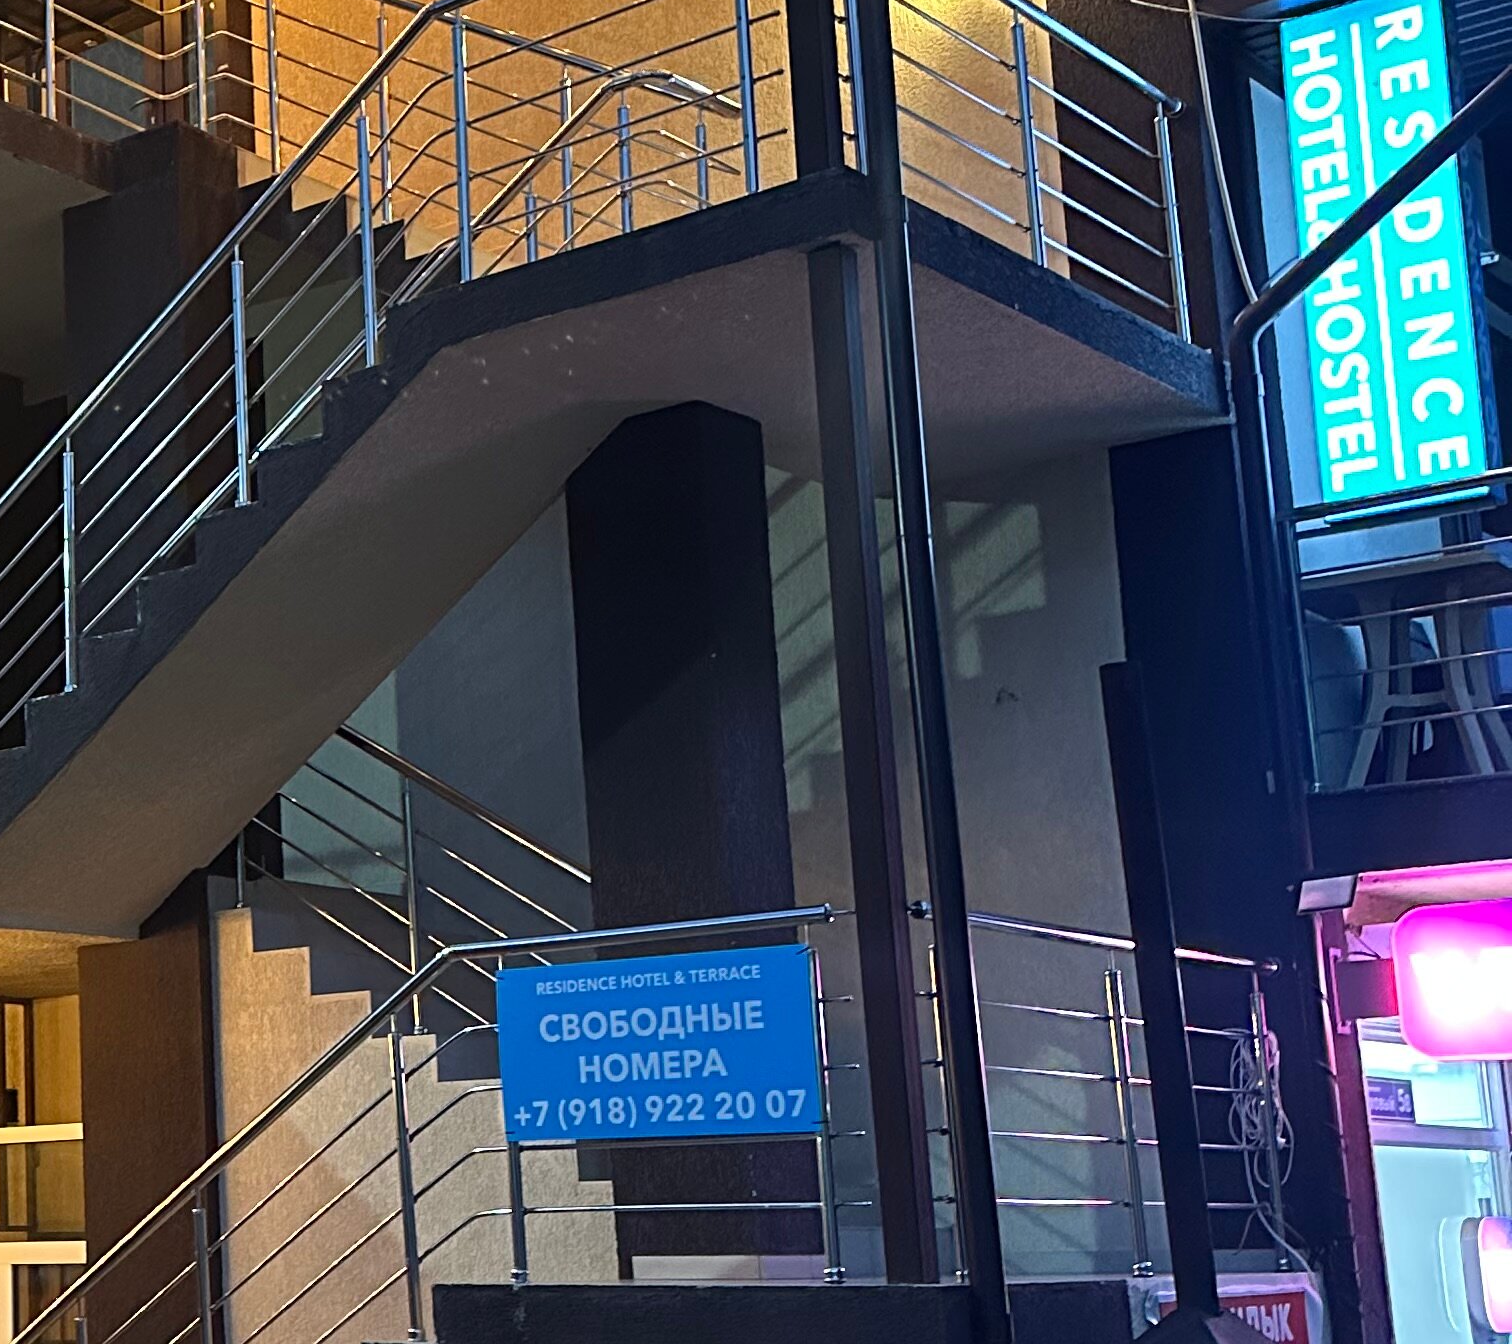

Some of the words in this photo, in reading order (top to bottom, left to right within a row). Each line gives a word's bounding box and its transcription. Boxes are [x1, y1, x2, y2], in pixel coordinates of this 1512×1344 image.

[1374, 5, 1470, 475] RESDENCE
[536, 975, 617, 996] RESIDENCE
[621, 971, 671, 989] HOTEL
[674, 970, 686, 985] &
[689, 964, 761, 983] TERRACE
[539, 999, 765, 1043] СВОБОДНЫЕ
[579, 1048, 728, 1084] НОМЕРА
[514, 1100, 549, 1128] +7
[558, 1096, 638, 1131] (918)
[645, 1091, 705, 1123] 922
[715, 1090, 756, 1120] 20
[766, 1089, 807, 1118] 07
